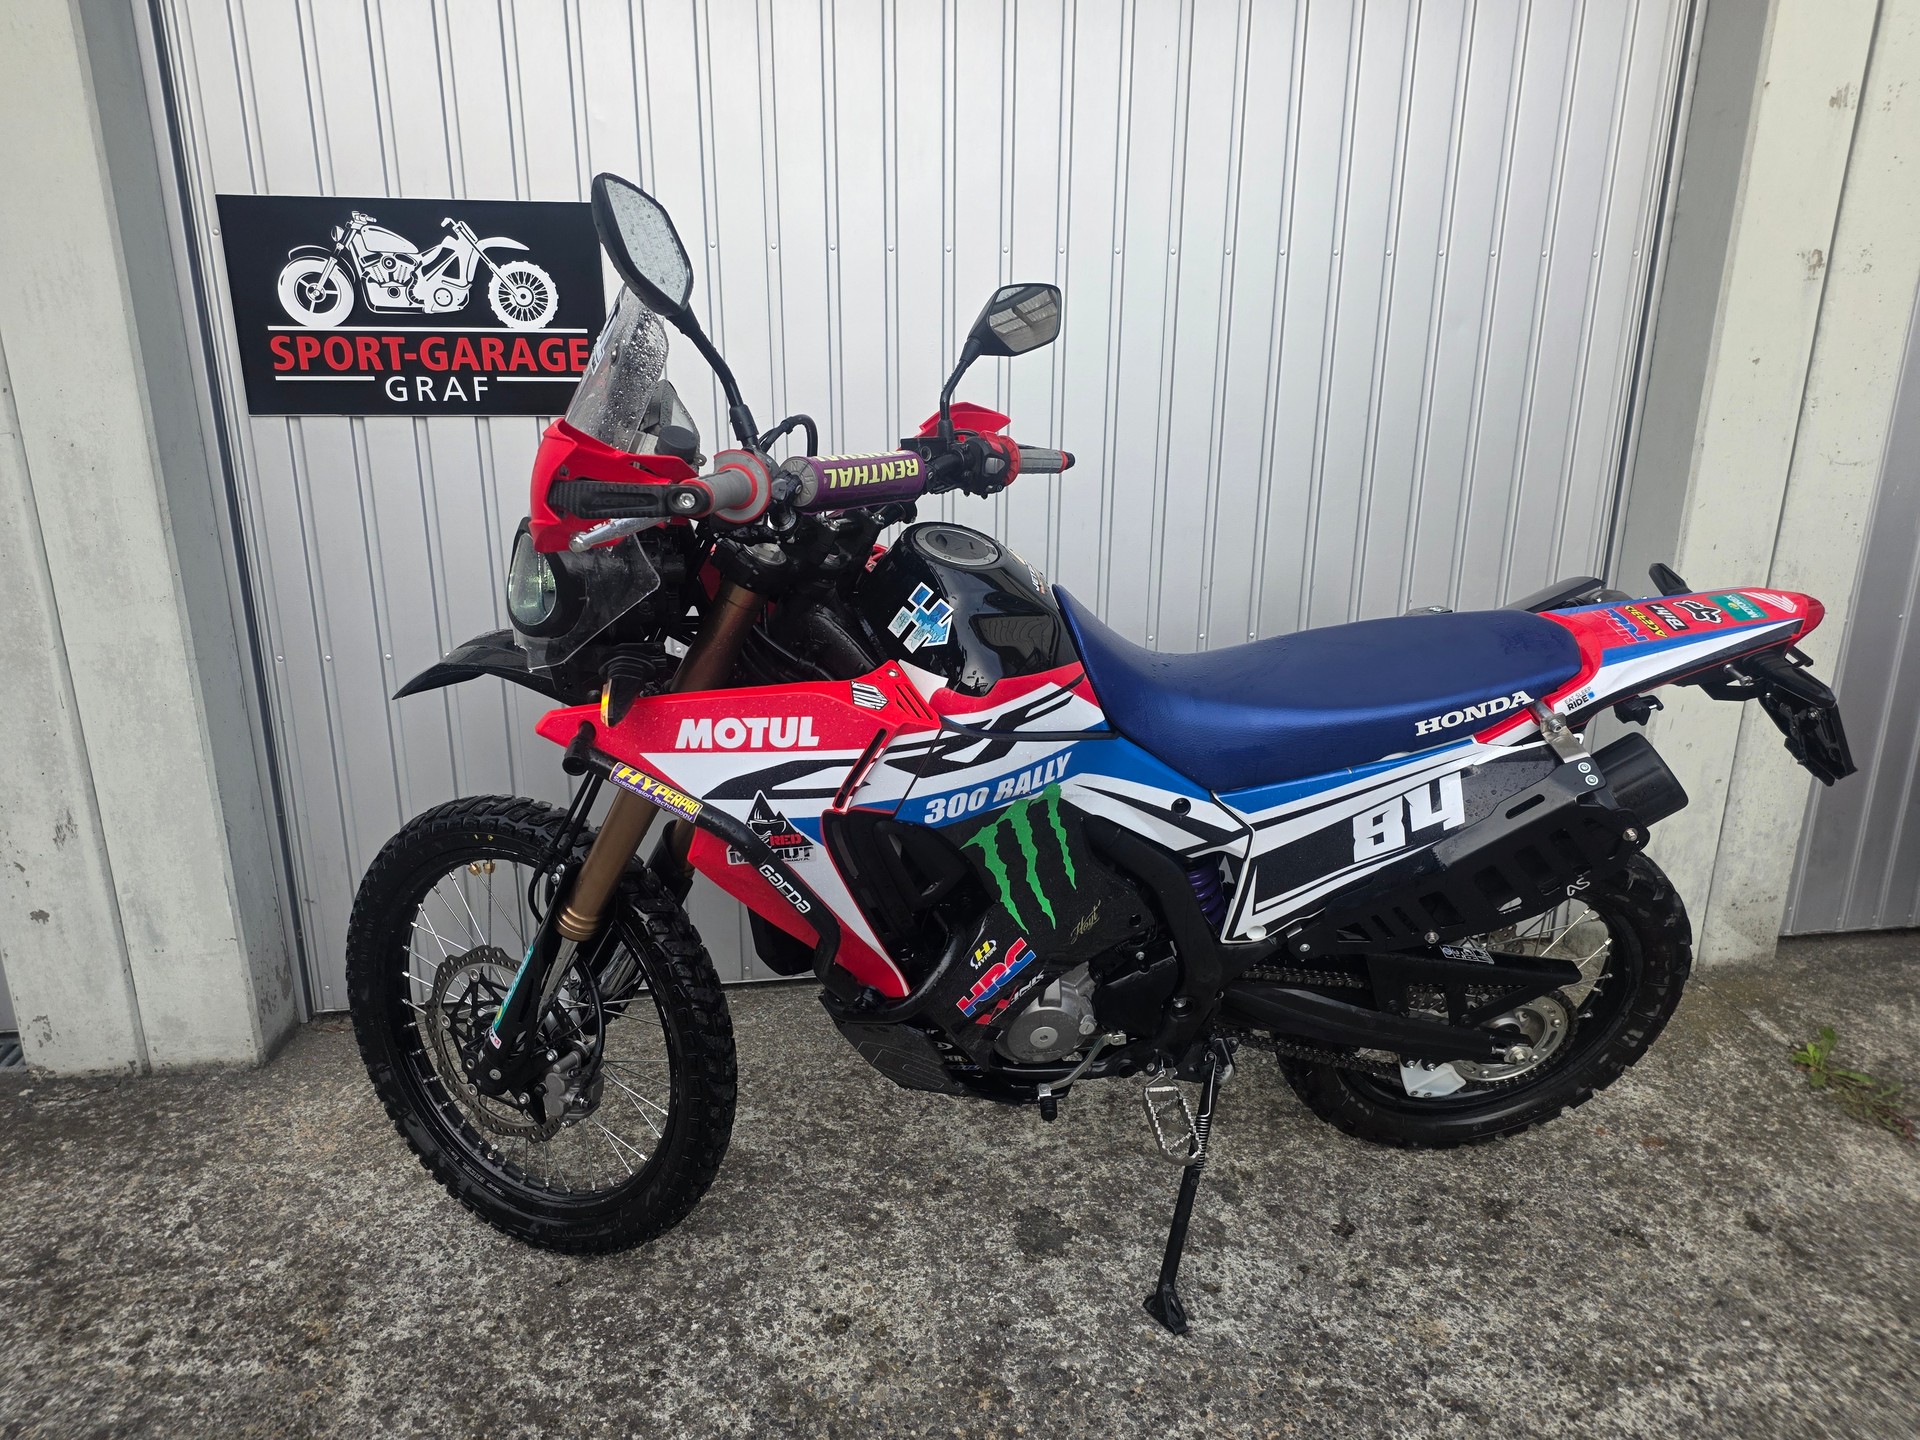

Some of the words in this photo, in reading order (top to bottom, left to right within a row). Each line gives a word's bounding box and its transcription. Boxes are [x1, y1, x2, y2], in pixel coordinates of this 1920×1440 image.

[269, 335, 589, 372] SPORT-GARAGE
[384, 376, 489, 402] GRAF
[823, 458, 919, 489] RENTHAL
[1414, 690, 1535, 737] HONDA
[1567, 694, 1590, 711] RIDE
[674, 716, 820, 749] MOTUL
[613, 775, 653, 800] Suspension
[654, 796, 693, 820] Technology
[615, 766, 700, 815] HYPERPRO
[924, 786, 990, 825] 300
[993, 751, 1073, 803] RALLY
[1352, 771, 1466, 864] 84
[769, 833, 802, 847] RED
